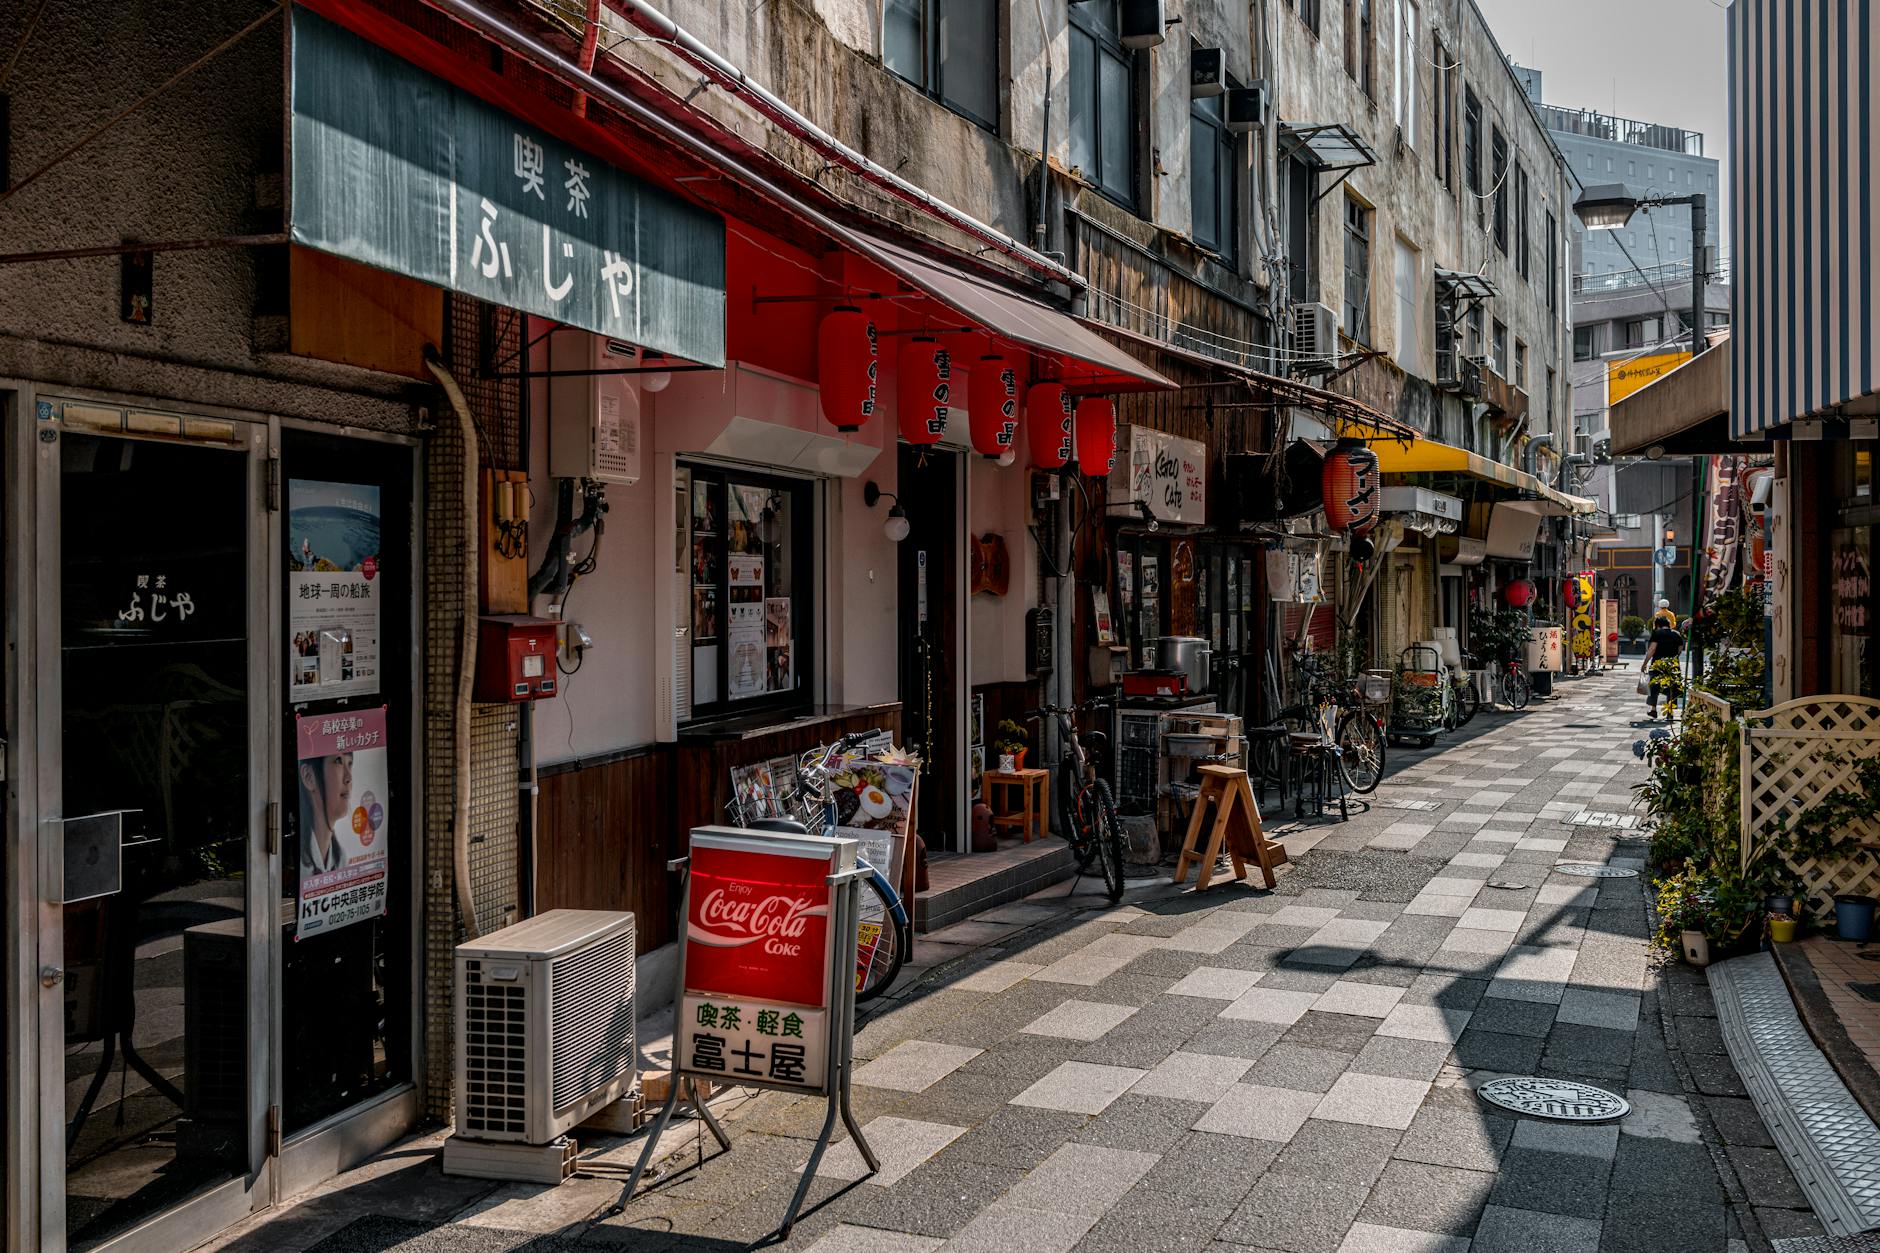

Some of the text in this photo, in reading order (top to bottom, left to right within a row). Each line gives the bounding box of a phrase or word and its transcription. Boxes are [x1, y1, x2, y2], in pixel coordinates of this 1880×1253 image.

[513, 132, 591, 219] 喫茶
[470, 197, 633, 318] ふじや
[1347, 452, 1378, 530] ラーメン
[136, 574, 167, 589] 喫茶
[298, 583, 371, 600] 地球一周の船旅
[118, 591, 195, 622] ふじや
[1539, 631, 1548, 669] ひょうたん
[321, 716, 363, 736] 高校卒業の
[336, 730, 380, 750] 新しいカタチ
[728, 881, 753, 896] Enjoy
[699, 888, 813, 938] Coca-Cola
[764, 937, 801, 957] Coke
[697, 1002, 804, 1039] 喫茶・軽食
